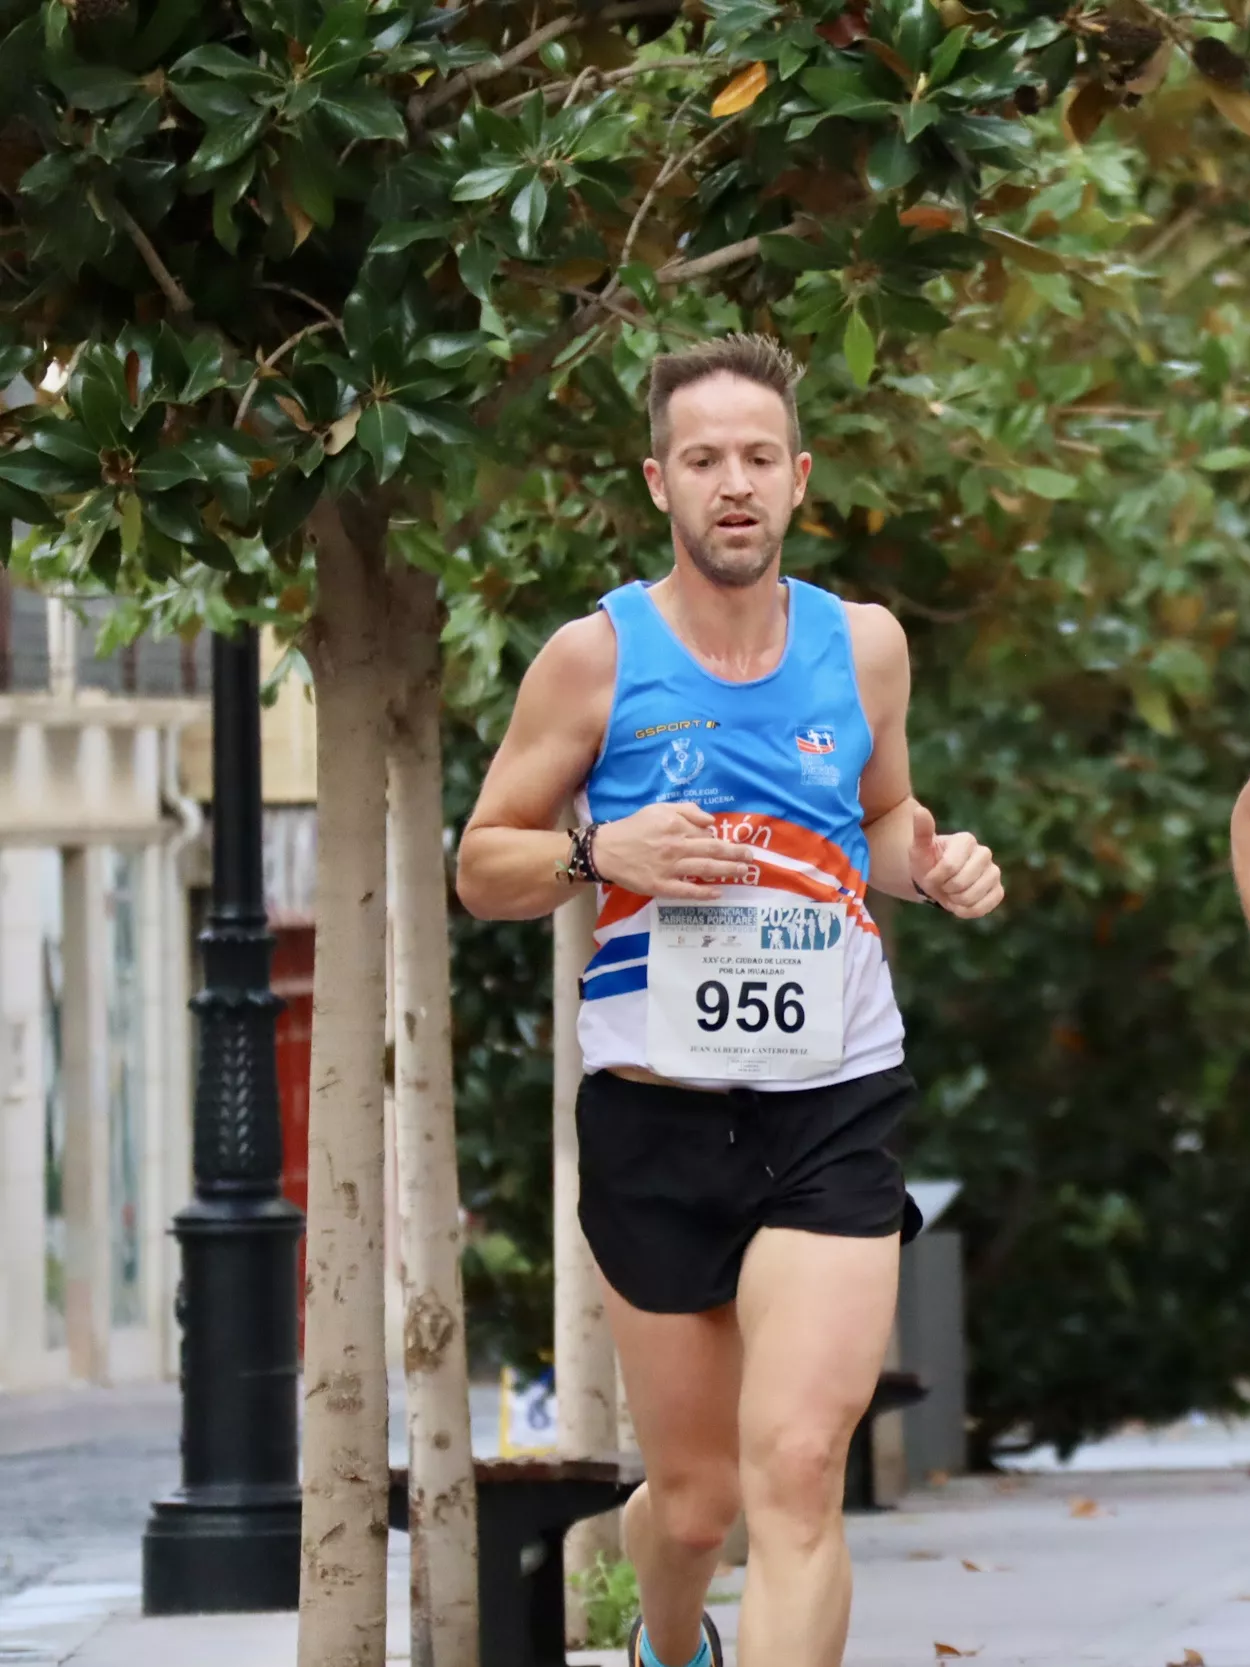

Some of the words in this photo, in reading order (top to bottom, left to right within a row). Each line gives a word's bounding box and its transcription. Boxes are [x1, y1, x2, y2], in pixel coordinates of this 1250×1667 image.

[635, 720, 701, 738] GSPORT
[684, 787, 718, 797] COLEGIO
[704, 796, 735, 805] LUCENA
[698, 907, 746, 916] PROVINCIAL
[706, 916, 758, 925] POPULARES
[719, 967, 733, 975] POR
[696, 979, 805, 1034] 956
[713, 1046, 750, 1054] ALBERTO
